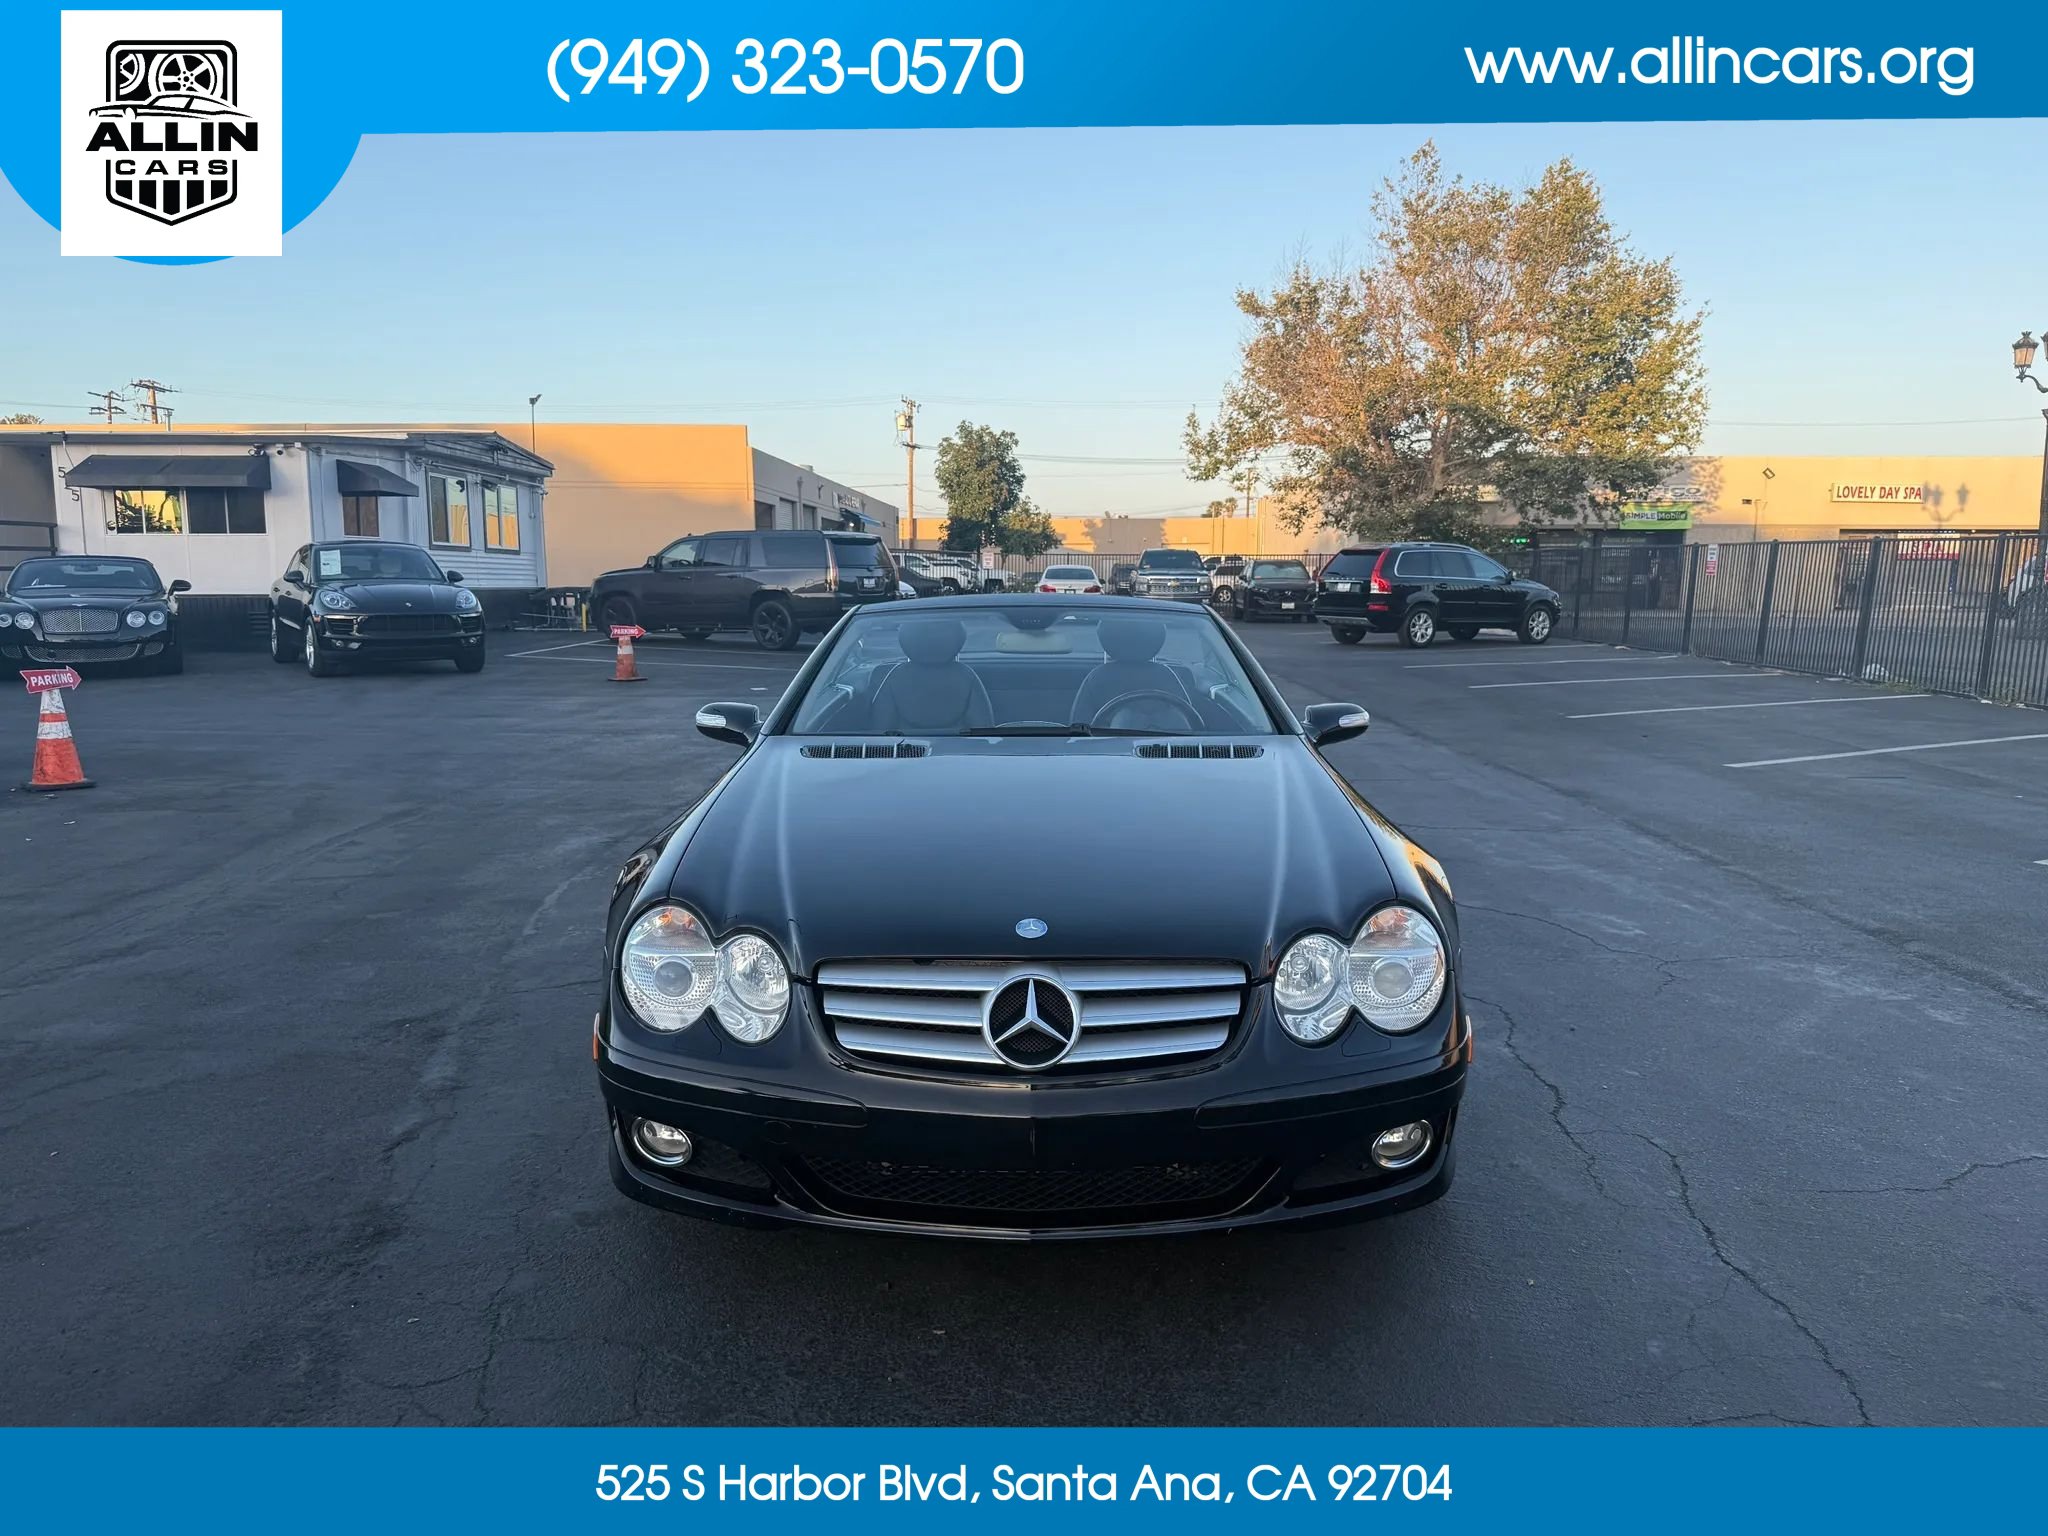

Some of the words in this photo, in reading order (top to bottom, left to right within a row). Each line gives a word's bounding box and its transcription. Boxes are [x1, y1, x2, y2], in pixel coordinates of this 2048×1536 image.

[1836, 485, 1876, 499] LOVELY
[1879, 486, 1901, 499] DAY
[1903, 487, 1922, 500] SPA
[30, 672, 74, 687] PARKING
